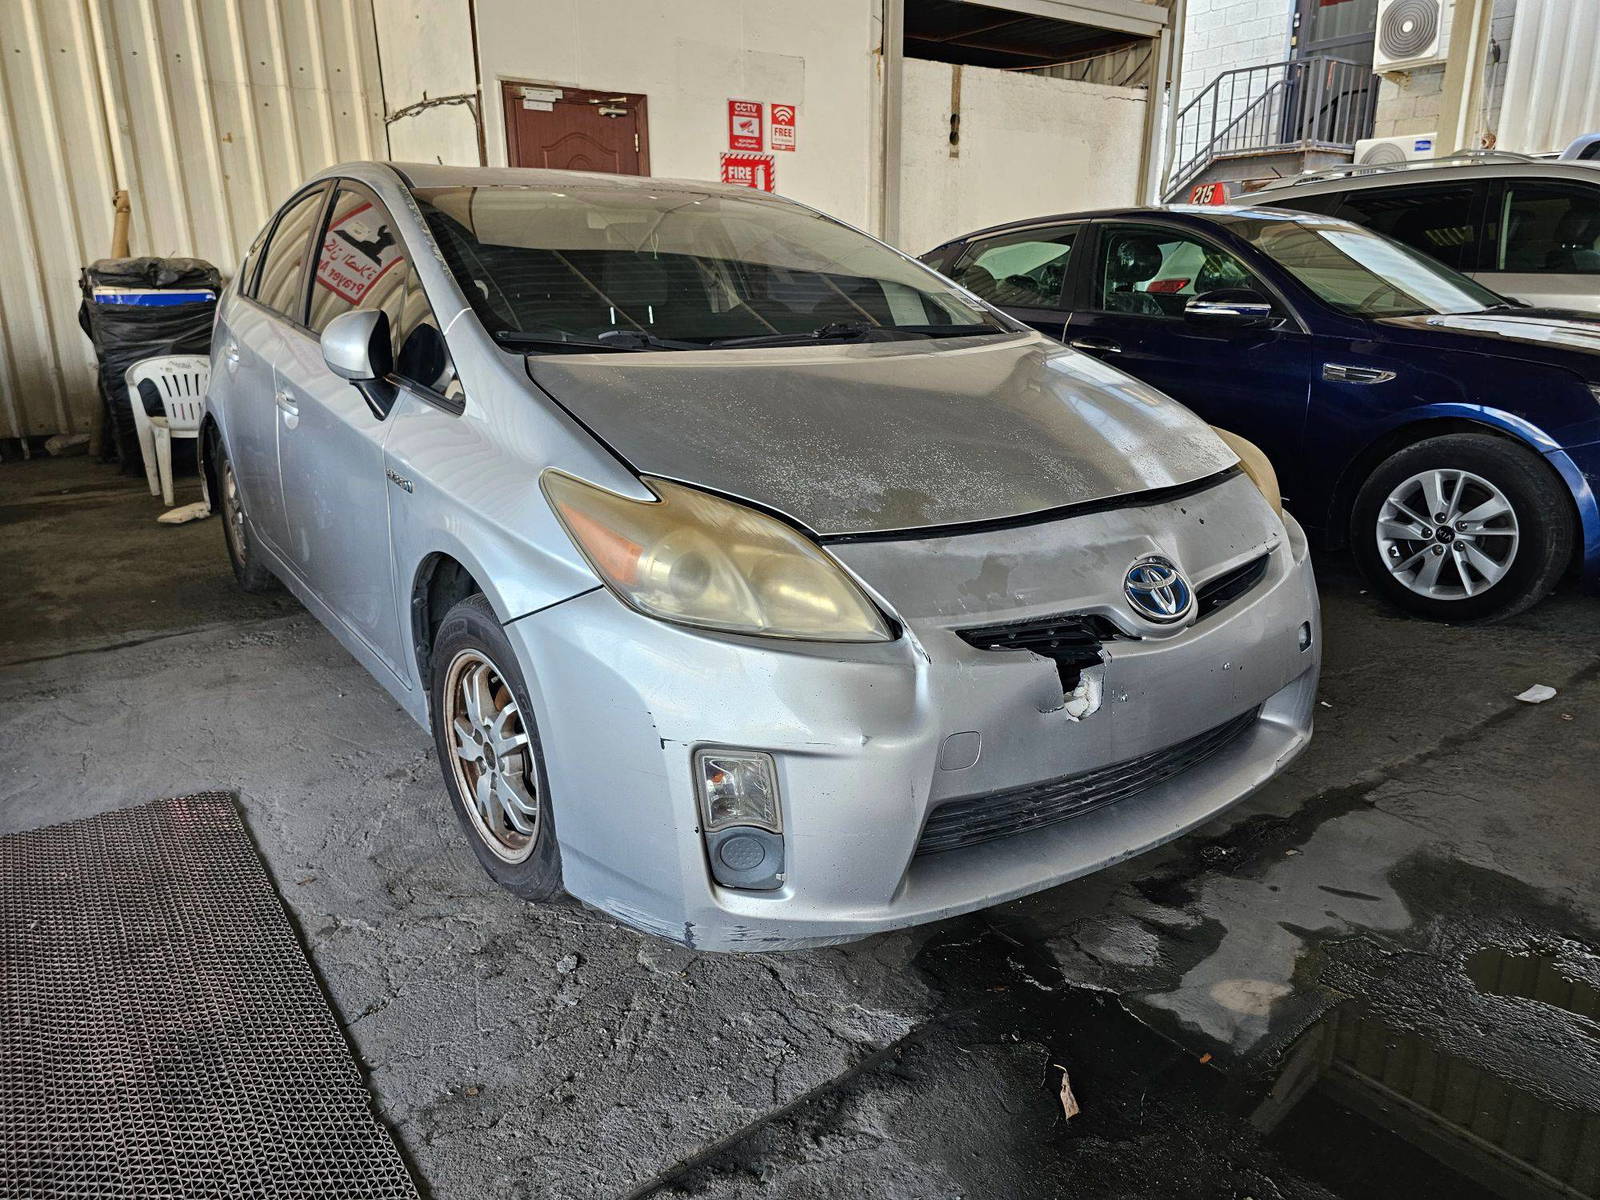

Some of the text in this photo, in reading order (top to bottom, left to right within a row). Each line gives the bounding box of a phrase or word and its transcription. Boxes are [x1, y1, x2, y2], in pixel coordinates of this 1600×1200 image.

[735, 102, 757, 112] CCTV
[774, 127, 792, 138] FREE
[728, 166, 752, 179] FIRE
[1192, 184, 1216, 205] 215
[1437, 528, 1452, 541] KIA
